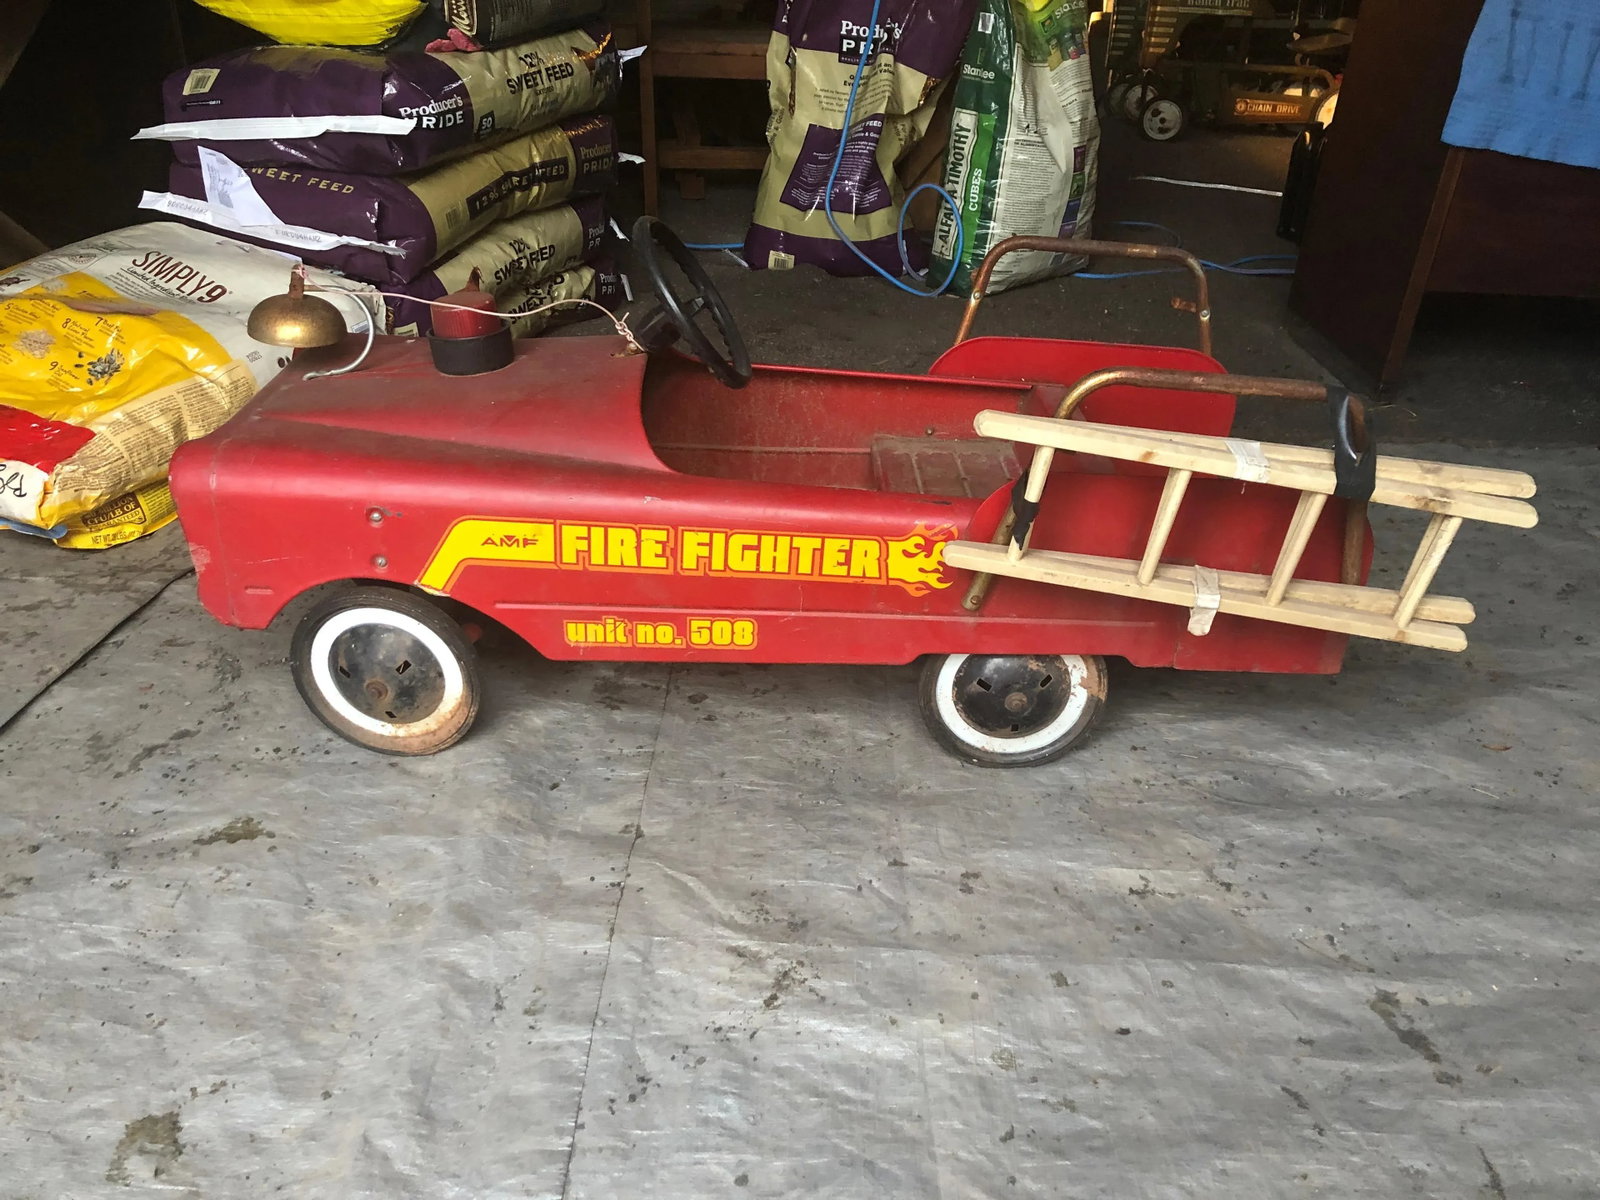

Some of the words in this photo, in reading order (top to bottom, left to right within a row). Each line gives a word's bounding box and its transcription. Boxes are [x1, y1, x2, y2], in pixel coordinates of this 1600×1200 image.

[506, 69, 545, 95] SWEET
[545, 62, 574, 84] FEED
[398, 95, 463, 119] Producer's
[1247, 104, 1273, 114] CHAIN
[1276, 104, 1300, 115] DRIVE
[412, 111, 464, 129] RIDE
[481, 117, 493, 131] 50
[947, 123, 972, 186] TIMOTHY
[245, 167, 302, 184] WEET
[306, 176, 355, 195] FEED
[969, 168, 983, 211] CUBES
[62, 317, 72, 329] 8
[94, 316, 104, 327] 7
[49, 360, 59, 371] 9
[123, 501, 137, 512] OF
[480, 534, 539, 549] AMF
[559, 523, 670, 569] FIRE
[681, 529, 882, 579] FIGHTER
[564, 616, 629, 645] unit
[636, 621, 684, 646] no.
[689, 619, 756, 647] 508
